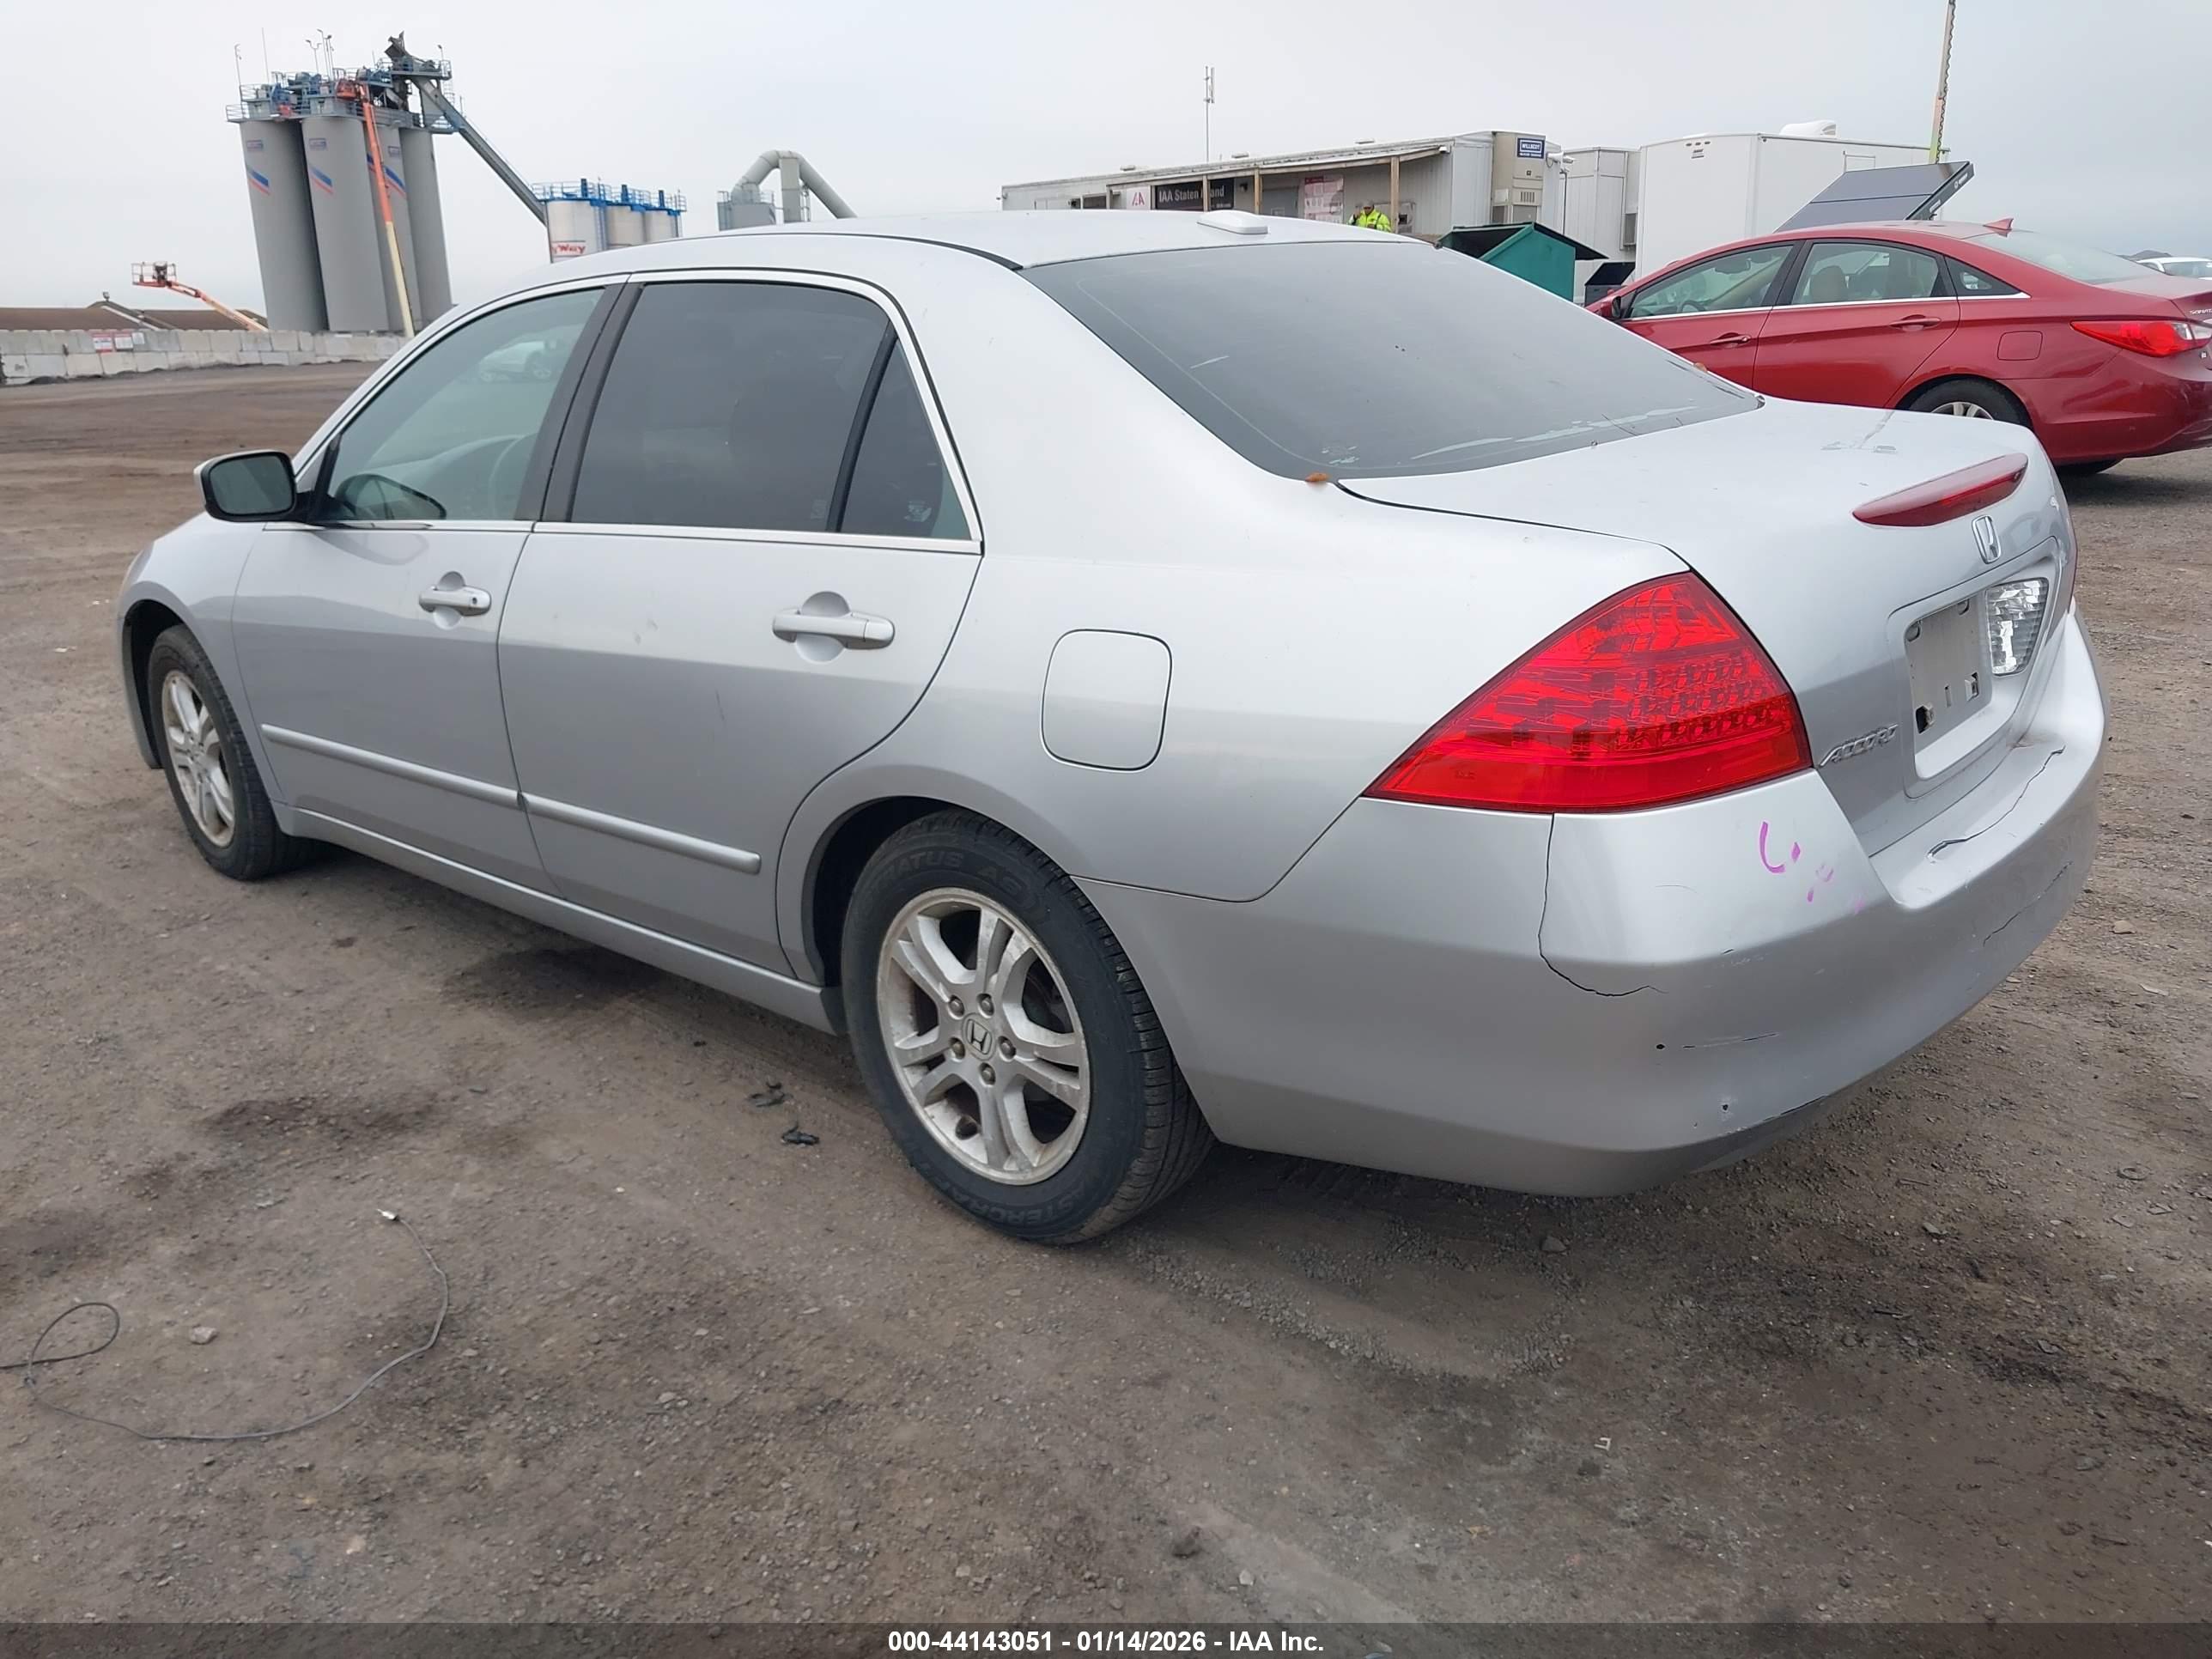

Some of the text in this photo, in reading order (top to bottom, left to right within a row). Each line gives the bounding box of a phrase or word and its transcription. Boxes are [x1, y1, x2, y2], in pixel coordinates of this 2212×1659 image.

[1158, 185, 1224, 203] IAA Staten Iand
